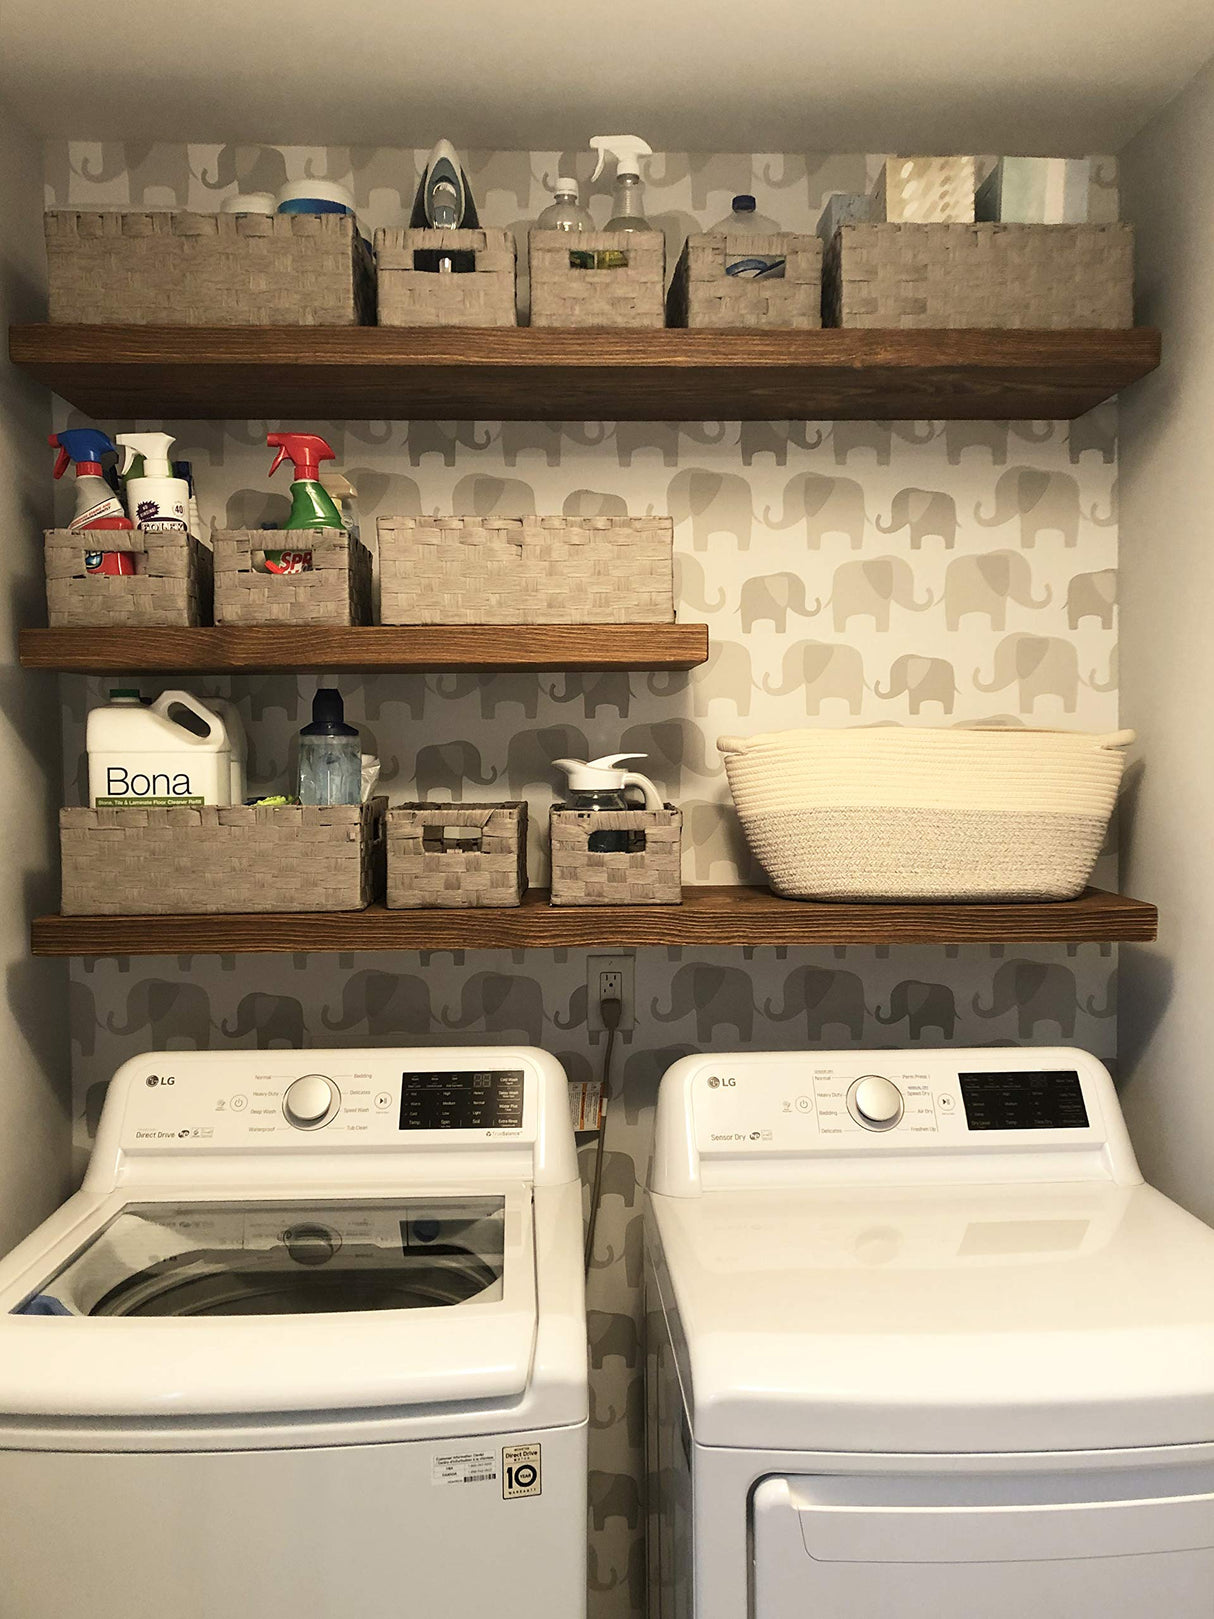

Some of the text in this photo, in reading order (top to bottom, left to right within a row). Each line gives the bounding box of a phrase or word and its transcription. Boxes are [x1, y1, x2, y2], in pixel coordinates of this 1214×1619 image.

[174, 505, 184, 514] 40
[107, 767, 192, 796] Bona
[161, 1076, 175, 1085] LG
[722, 1078, 736, 1086] LG
[507, 1464, 537, 1489] 10
